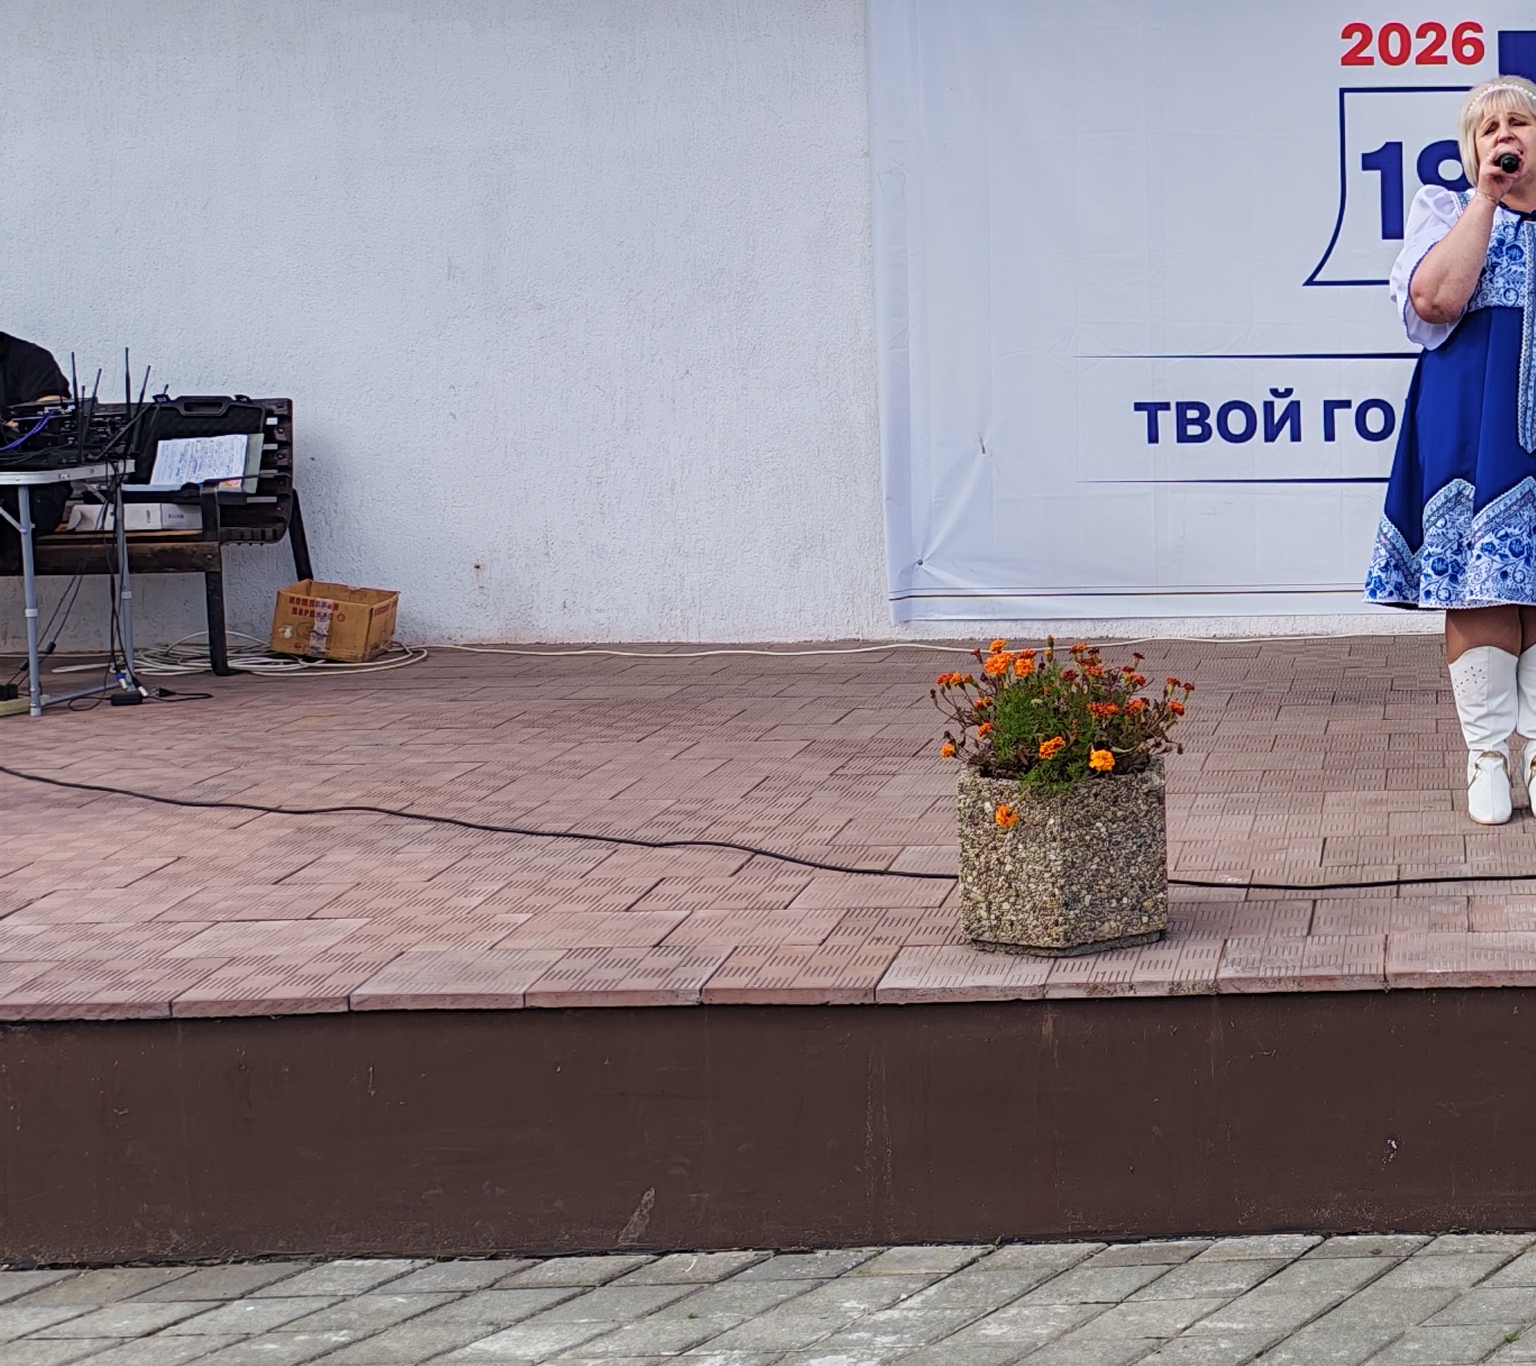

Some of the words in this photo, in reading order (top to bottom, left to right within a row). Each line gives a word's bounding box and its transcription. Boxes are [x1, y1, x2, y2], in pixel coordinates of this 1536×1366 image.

[1340, 21, 1485, 66] 2026
[1133, 387, 1302, 444] ТВОЙ
[1323, 398, 1398, 442] ГО
